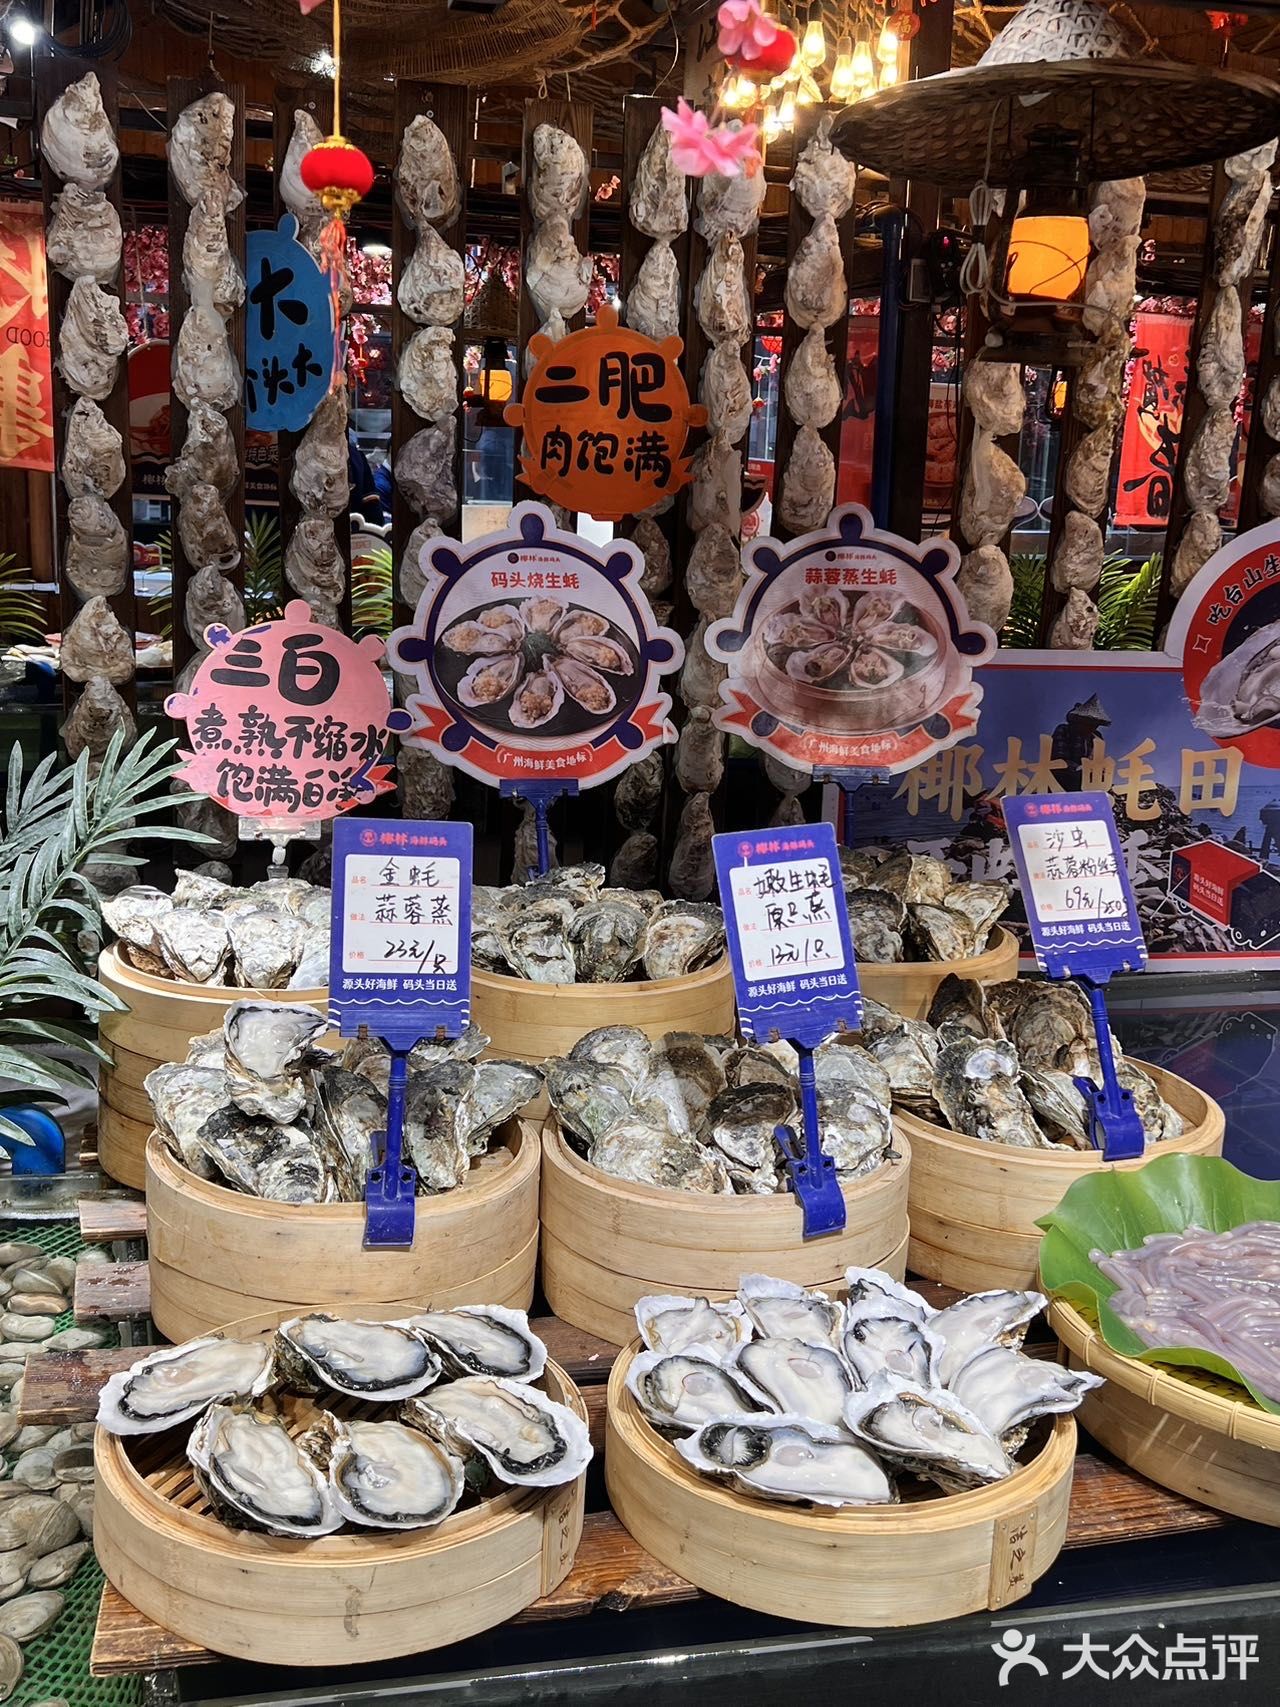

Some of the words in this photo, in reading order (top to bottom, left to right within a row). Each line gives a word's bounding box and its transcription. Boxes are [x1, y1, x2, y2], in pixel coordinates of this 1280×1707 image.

[250, 257, 309, 340] 大
[535, 351, 673, 423] 二肥
[541, 424, 671, 488] 肉饱满
[490, 572, 579, 589] 码头烧生蚝
[805, 567, 897, 585] 蒜蓉蒸生蚝
[210, 633, 341, 706] 三白
[192, 702, 388, 761] 煮熟不缩水
[893, 736, 1244, 821] 椰林蚝田
[1046, 826, 1088, 851] 沙虫
[375, 894, 453, 926] 蒜蓉蒸
[343, 978, 398, 991] 源头好海鲜
[403, 979, 457, 991] 码头当日送
[748, 980, 796, 997] 源头好海鲜
[800, 973, 848, 990] 码头当日送
